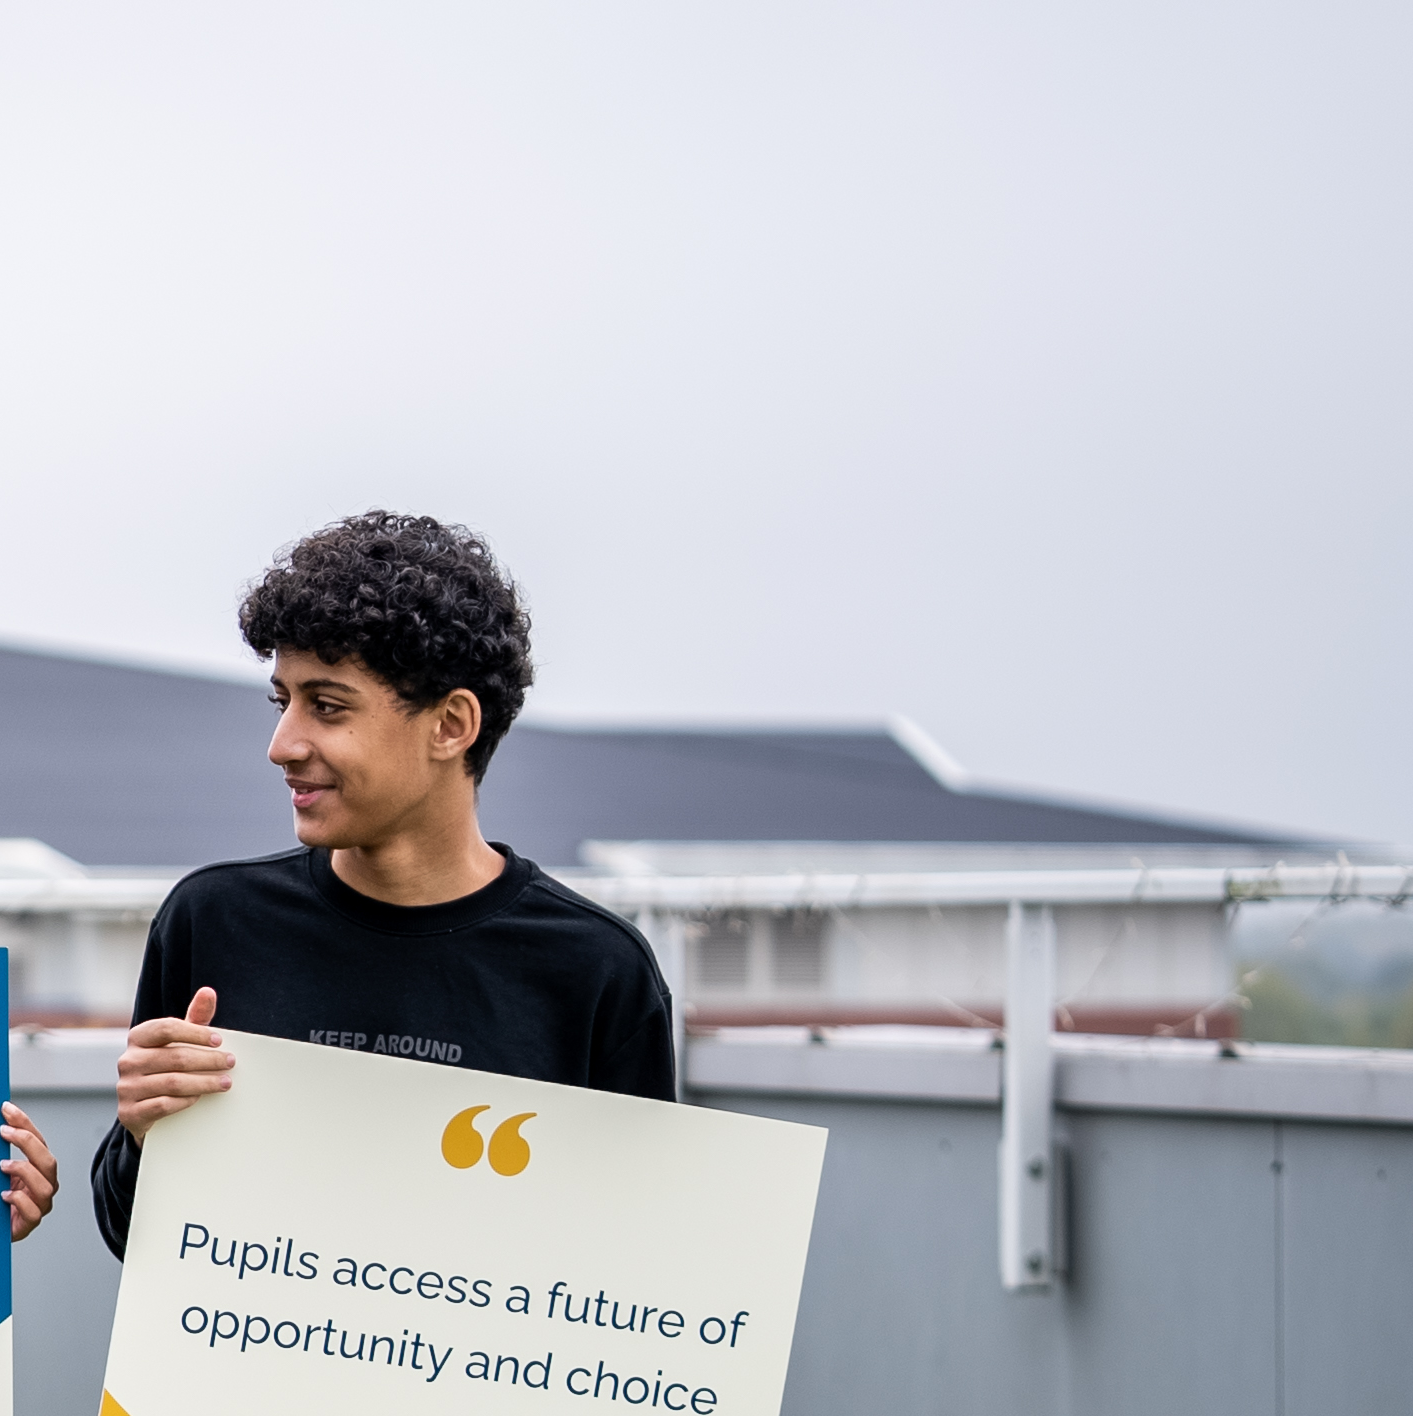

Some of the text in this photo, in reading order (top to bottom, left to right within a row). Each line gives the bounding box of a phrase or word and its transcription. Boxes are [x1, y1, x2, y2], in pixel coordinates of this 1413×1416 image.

[309, 1029, 463, 1063] KEEP AROUND
[179, 1222, 750, 1348] Pupils access a future of
[181, 1306, 718, 1416] opportunity and choice
